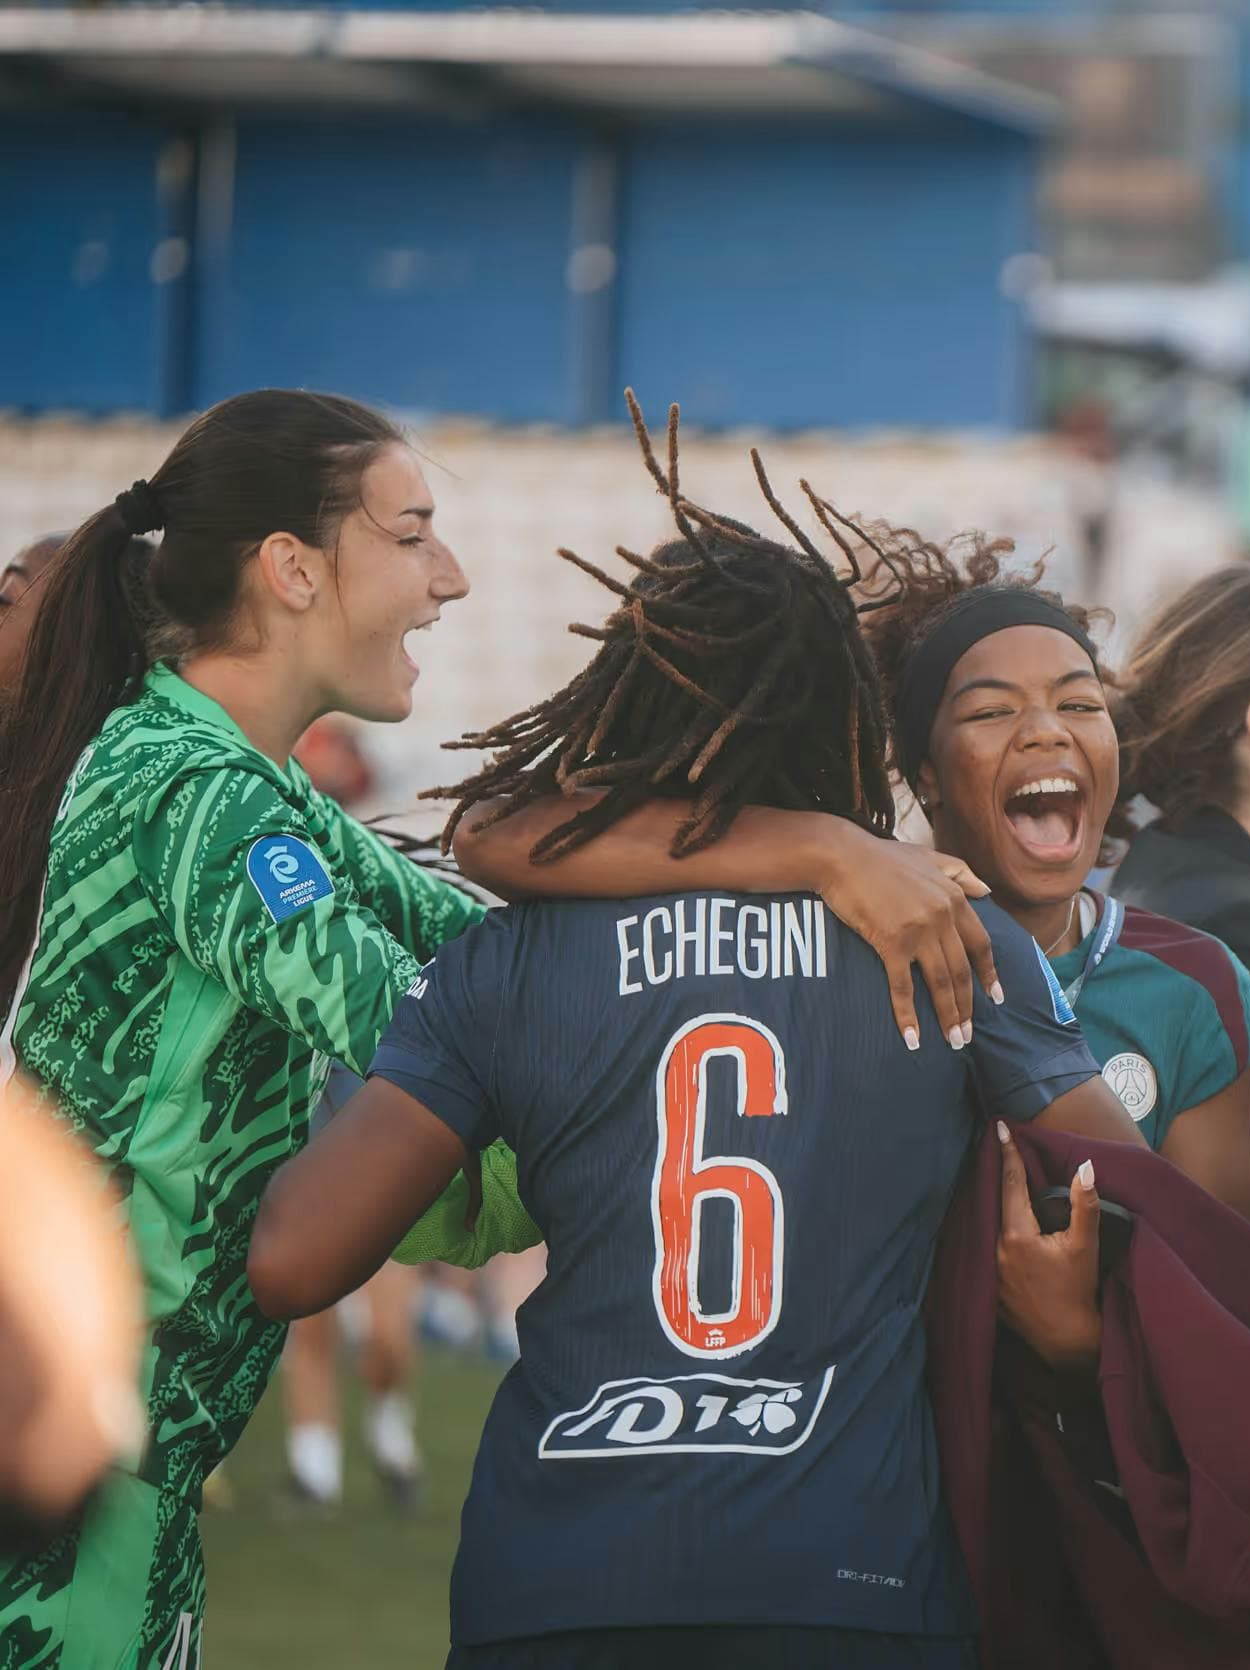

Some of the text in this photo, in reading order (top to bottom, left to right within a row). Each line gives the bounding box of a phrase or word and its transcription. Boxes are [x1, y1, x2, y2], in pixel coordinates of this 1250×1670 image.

[280, 879, 316, 899] ARKEMA
[293, 893, 315, 907] LIGUE
[616, 898, 828, 997] ECHEGINI
[1110, 1058, 1147, 1075] PARIS
[651, 1012, 789, 1361] 6
